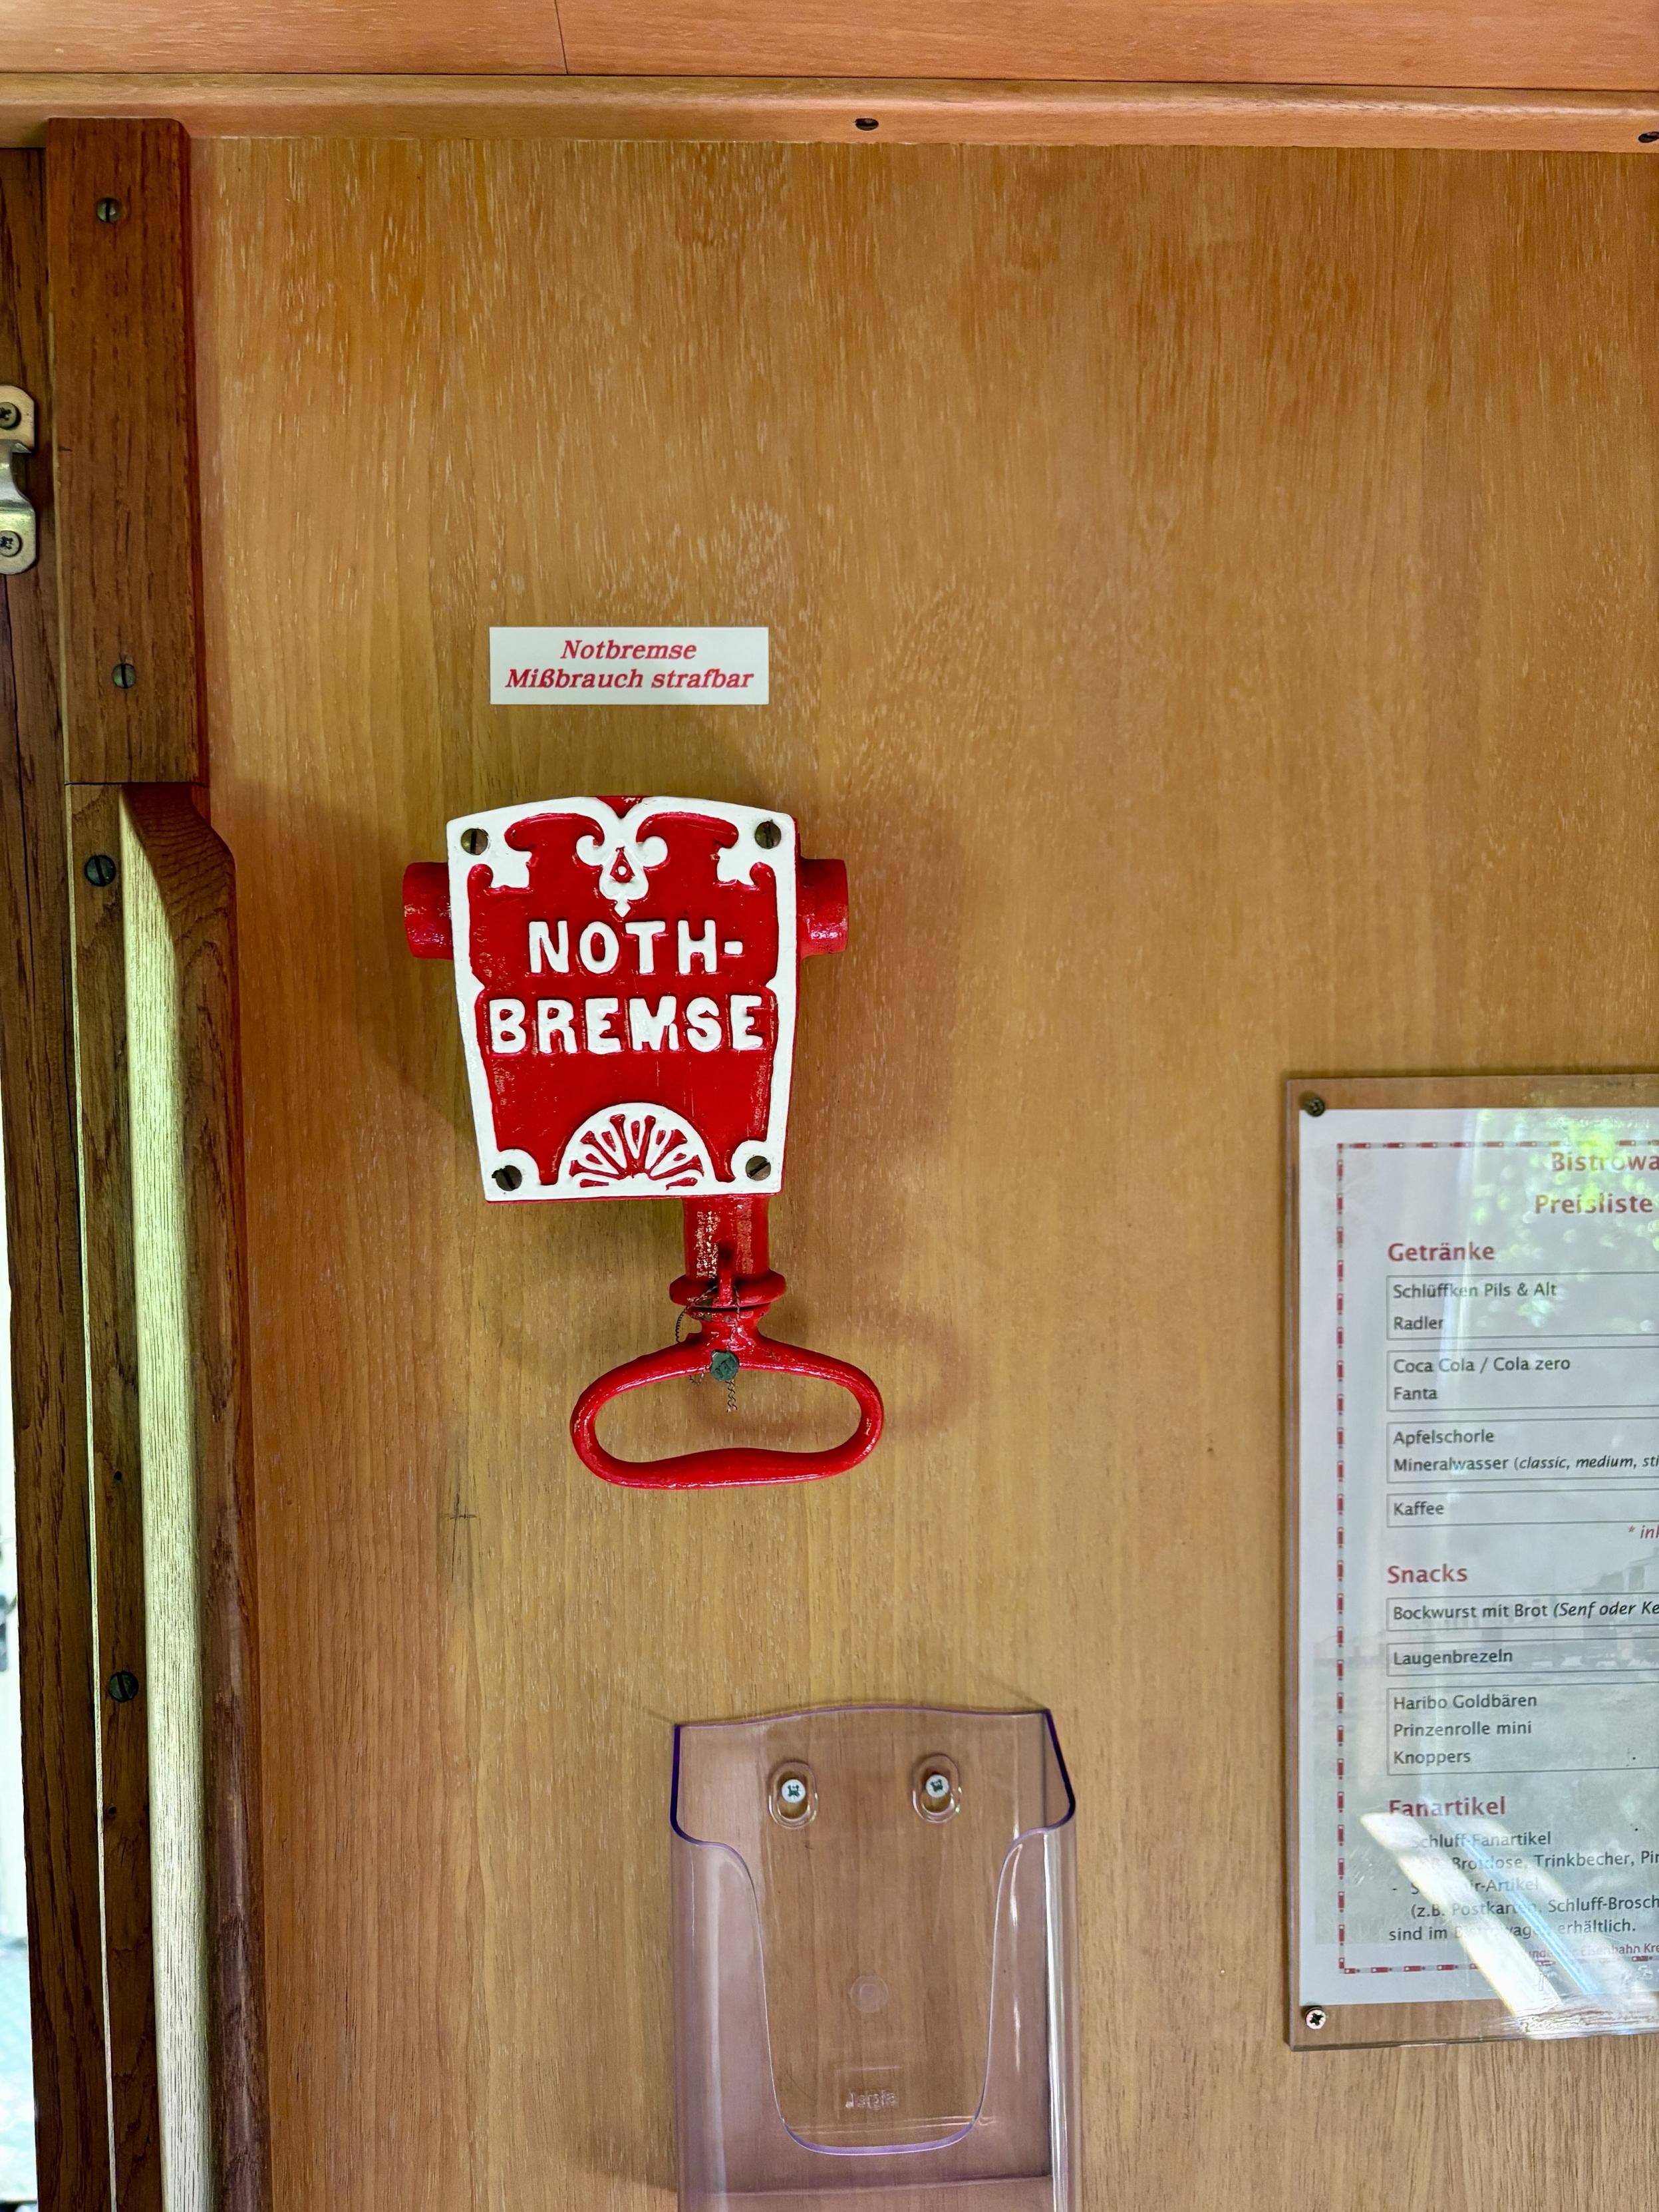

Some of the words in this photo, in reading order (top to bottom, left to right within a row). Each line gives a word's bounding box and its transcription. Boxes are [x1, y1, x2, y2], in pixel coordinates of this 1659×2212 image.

[560, 639, 696, 659] Notbremse
[504, 669, 643, 689] Mißbrauch
[651, 669, 754, 689] strafbar
[529, 919, 744, 974] NOTH-
[490, 994, 764, 1054] BREMSE
[1535, 1193, 1652, 1213] Preisliste
[1388, 1241, 1494, 1261] Getränke
[1393, 1283, 1477, 1299] Schlüffken
[1484, 1283, 1511, 1297] Pils
[1517, 1282, 1528, 1297] &
[1534, 1281, 1557, 1297] Alt
[1394, 1316, 1444, 1330] Radler
[1394, 1359, 1433, 1373] Coca
[1438, 1358, 1475, 1372] Cola
[1479, 1357, 1488, 1374] /
[1493, 1356, 1530, 1371] Cola
[1535, 1358, 1571, 1370] zero
[1394, 1387, 1437, 1400] Fanta
[1393, 1429, 1495, 1447] Apfelschorle
[1394, 1457, 1508, 1472] Mineralwasser
[1513, 1456, 1571, 1471] (classic,
[1576, 1455, 1637, 1469] medium,
[1394, 1501, 1444, 1516] Kaffee
[1387, 1564, 1467, 1584] Snacks
[1393, 1605, 1477, 1620] Bockwurst
[1482, 1604, 1509, 1618] mit
[1515, 1604, 1548, 1618] Brot
[1553, 1602, 1596, 1619] (Senf
[1599, 1601, 1636, 1616] oder
[1641, 1601, 1659, 1615] Ke
[1394, 1649, 1513, 1668] Laugenbrezeln
[1394, 1696, 1447, 1710] Haribo
[1453, 1694, 1537, 1708] Goldbären
[1394, 1722, 1491, 1737] Prinzenrolle
[1497, 1721, 1532, 1734] mini
[1394, 1751, 1471, 1766] Knoppers
[1388, 1797, 1506, 1817] Fanartikel
[1533, 1851, 1634, 1867] Trinkbecher,
[1411, 1904, 1445, 1919] (z.B.
[1389, 1927, 1422, 1941] sind
[1428, 1927, 1447, 1939] im
[1559, 1918, 1636, 1935] erhältlich.
